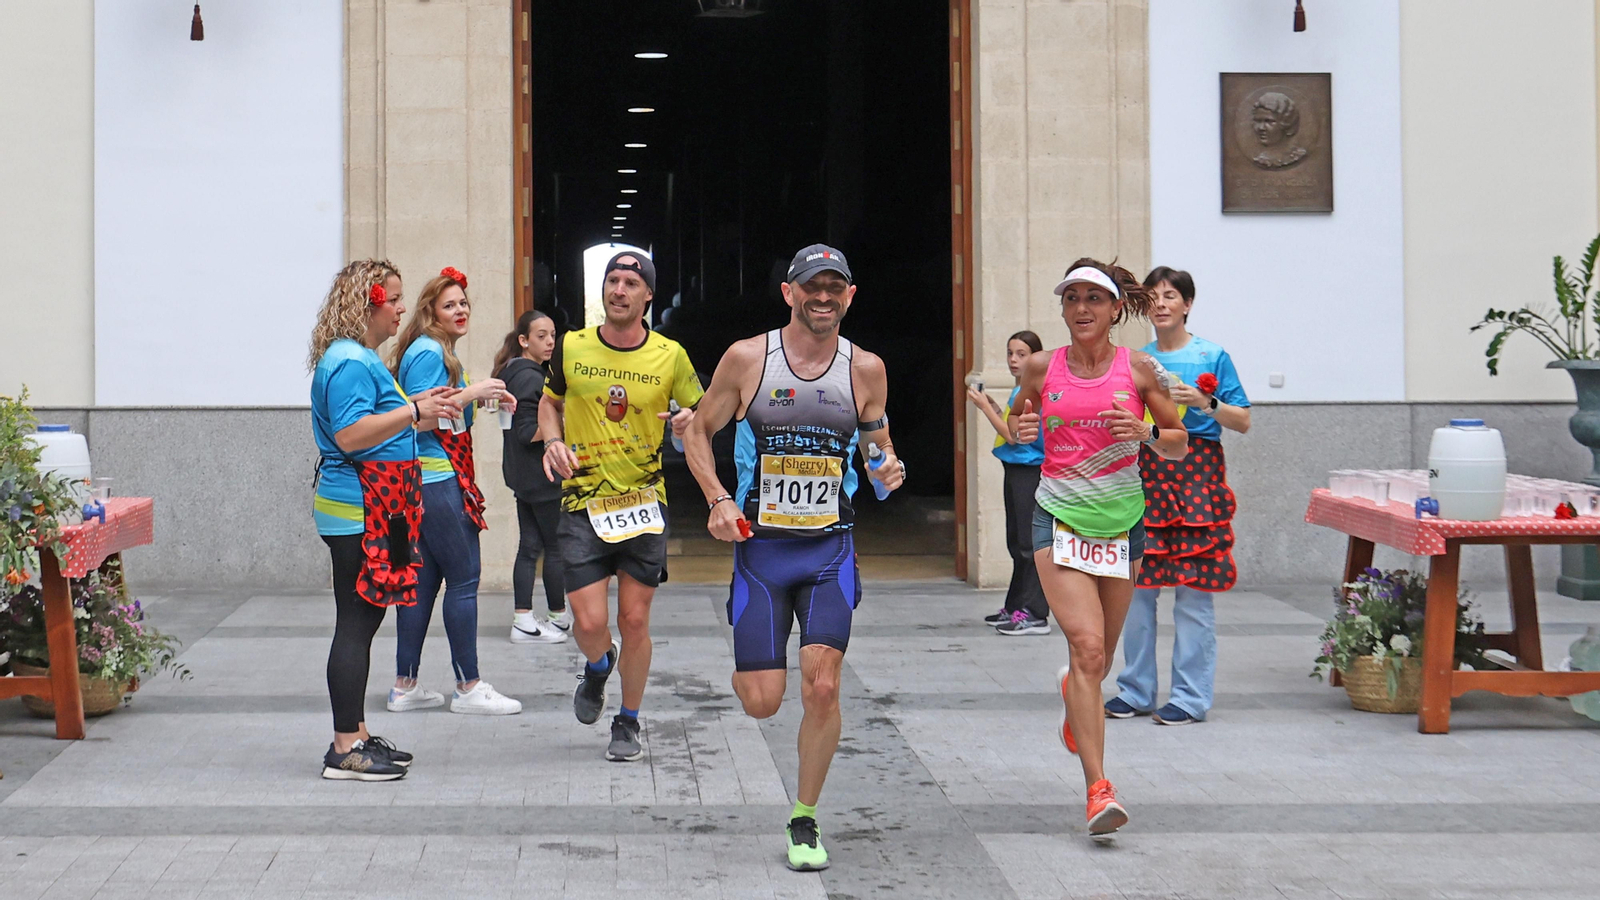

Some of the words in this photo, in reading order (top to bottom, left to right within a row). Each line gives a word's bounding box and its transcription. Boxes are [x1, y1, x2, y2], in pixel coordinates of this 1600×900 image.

[573, 362, 661, 386] Paparunners
[786, 458, 824, 473] Sherry
[606, 491, 640, 507] Sherry
[775, 479, 829, 505] 1012
[604, 509, 651, 530] 1518
[1067, 537, 1118, 565] 1065
